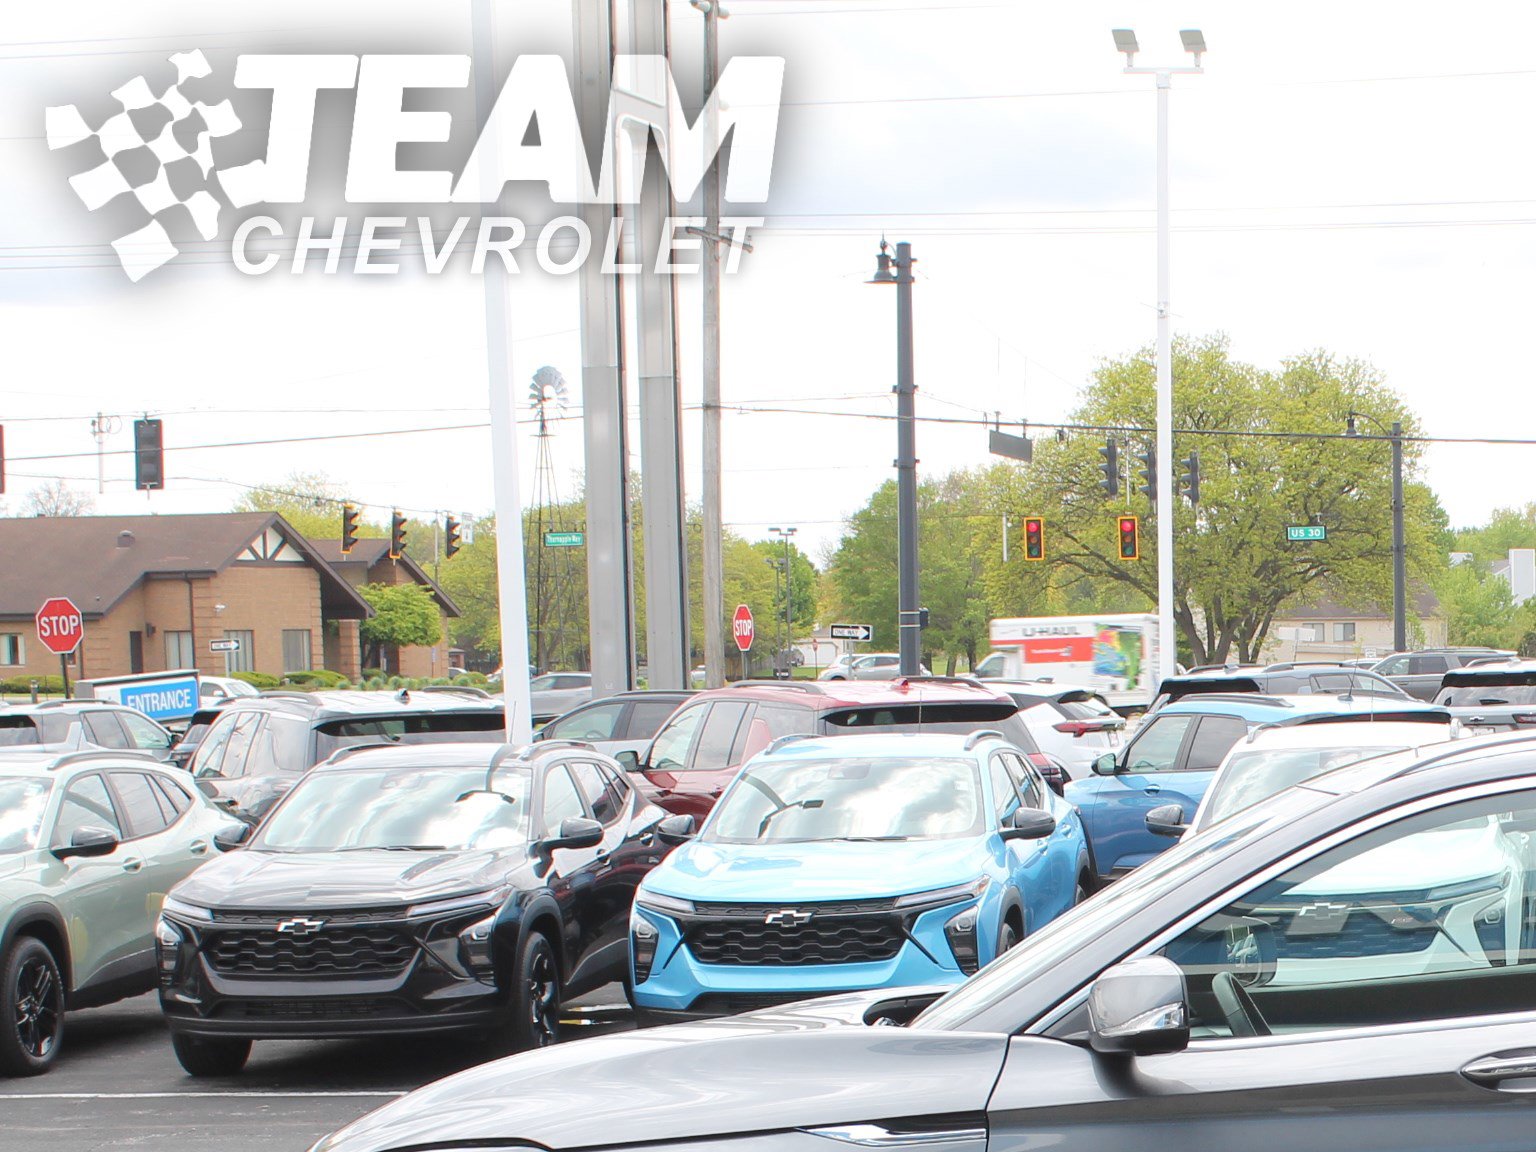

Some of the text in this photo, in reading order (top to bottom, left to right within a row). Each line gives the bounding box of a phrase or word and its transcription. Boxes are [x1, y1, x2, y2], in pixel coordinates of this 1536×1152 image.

[1291, 528, 1321, 537] US 30
[39, 614, 80, 638] STOP
[735, 619, 752, 636] STOP
[126, 689, 192, 714] ENTRANCE
